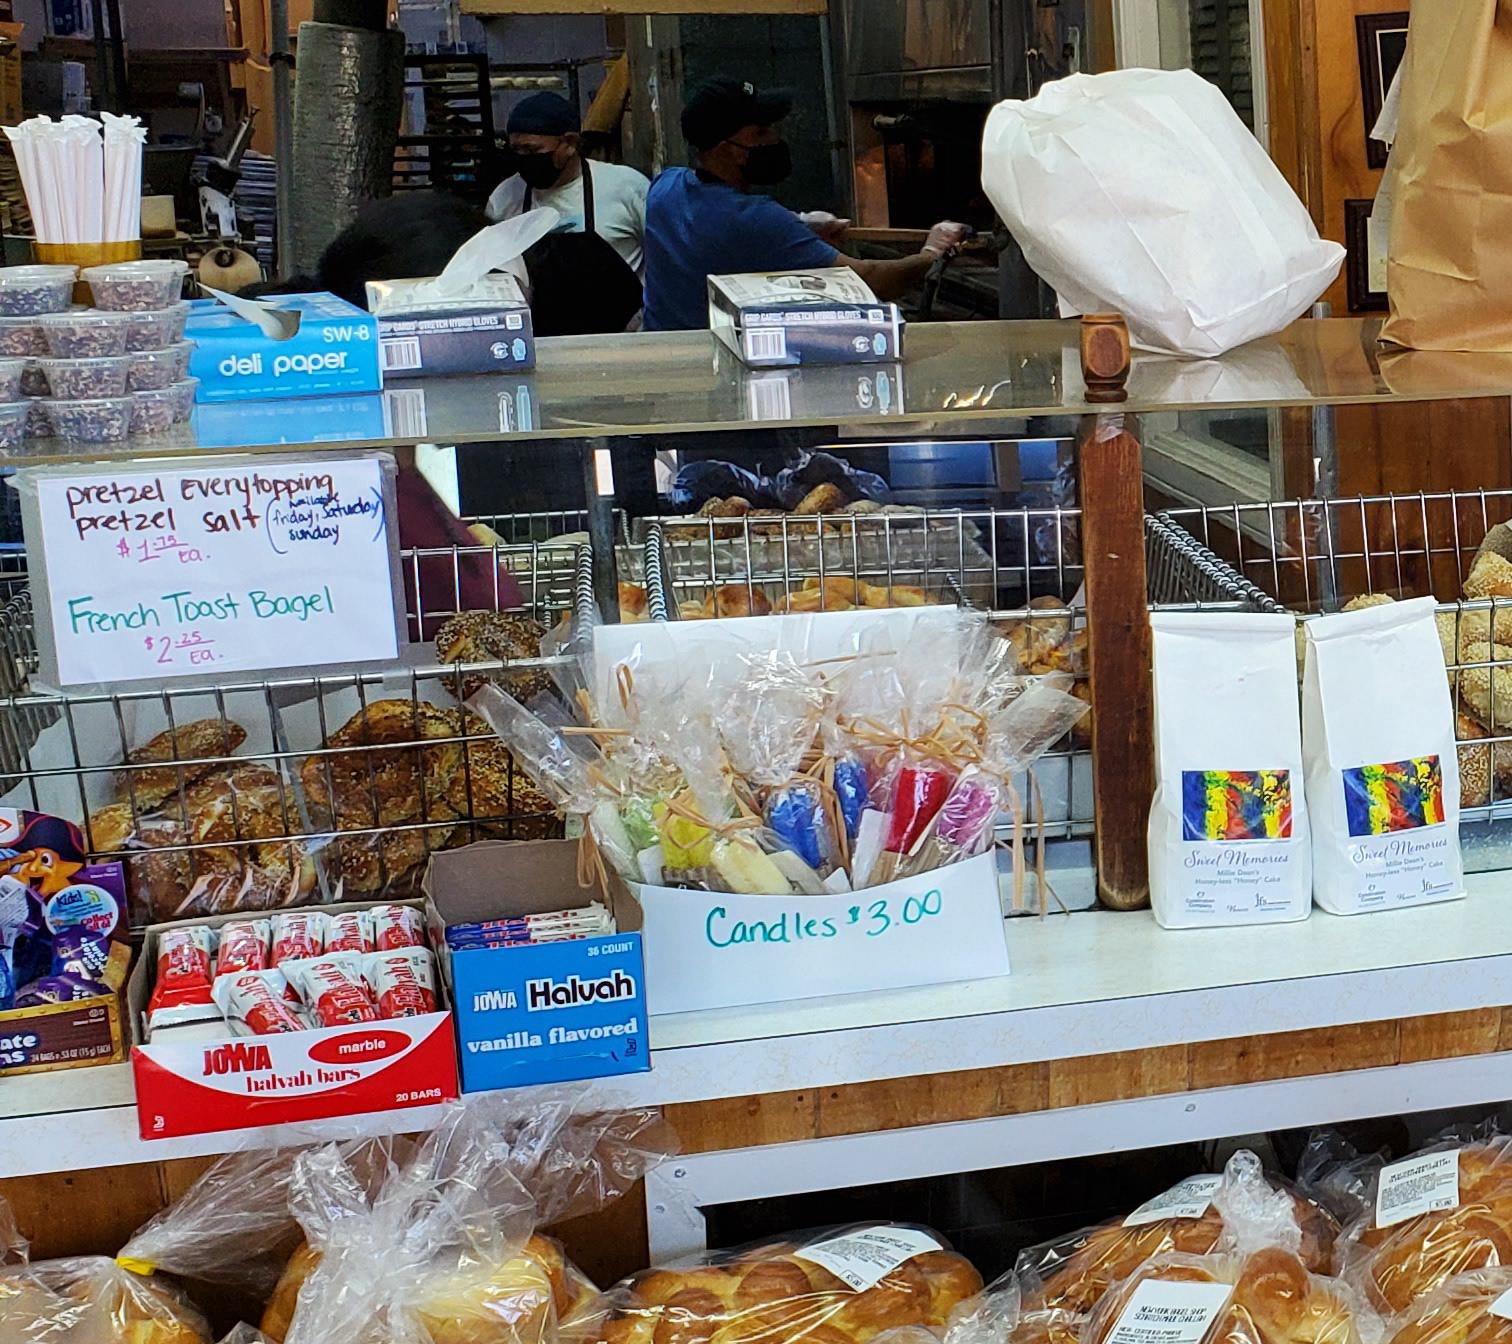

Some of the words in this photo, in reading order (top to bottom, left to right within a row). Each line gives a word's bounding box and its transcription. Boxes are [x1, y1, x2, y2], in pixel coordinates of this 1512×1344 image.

[323, 325, 370, 343] SW-8
[219, 352, 263, 376] deli
[274, 352, 347, 376] paper
[66, 478, 164, 519] pretzel
[76, 508, 176, 540] pretzel
[203, 505, 261, 532] salt
[288, 524, 339, 545] sunday
[68, 594, 159, 635] French
[162, 590, 239, 623] Toast
[249, 586, 335, 626] Bagel
[1223, 850, 1289, 866] Memories
[1390, 840, 1447, 856] Memories
[706, 906, 838, 949] Candles
[848, 889, 944, 936] $3.00
[588, 947, 600, 957] 36
[602, 941, 634, 955] COUNT
[529, 972, 633, 1009] Halvah
[338, 1039, 386, 1055] marble
[467, 1031, 543, 1053] vanilla
[549, 1018, 638, 1045] flavored
[203, 1042, 272, 1076] JOYVA
[246, 1071, 312, 1093] halvah
[318, 1067, 361, 1085] bars
[396, 1093, 408, 1102] 20
[410, 1088, 441, 1100] BARS
